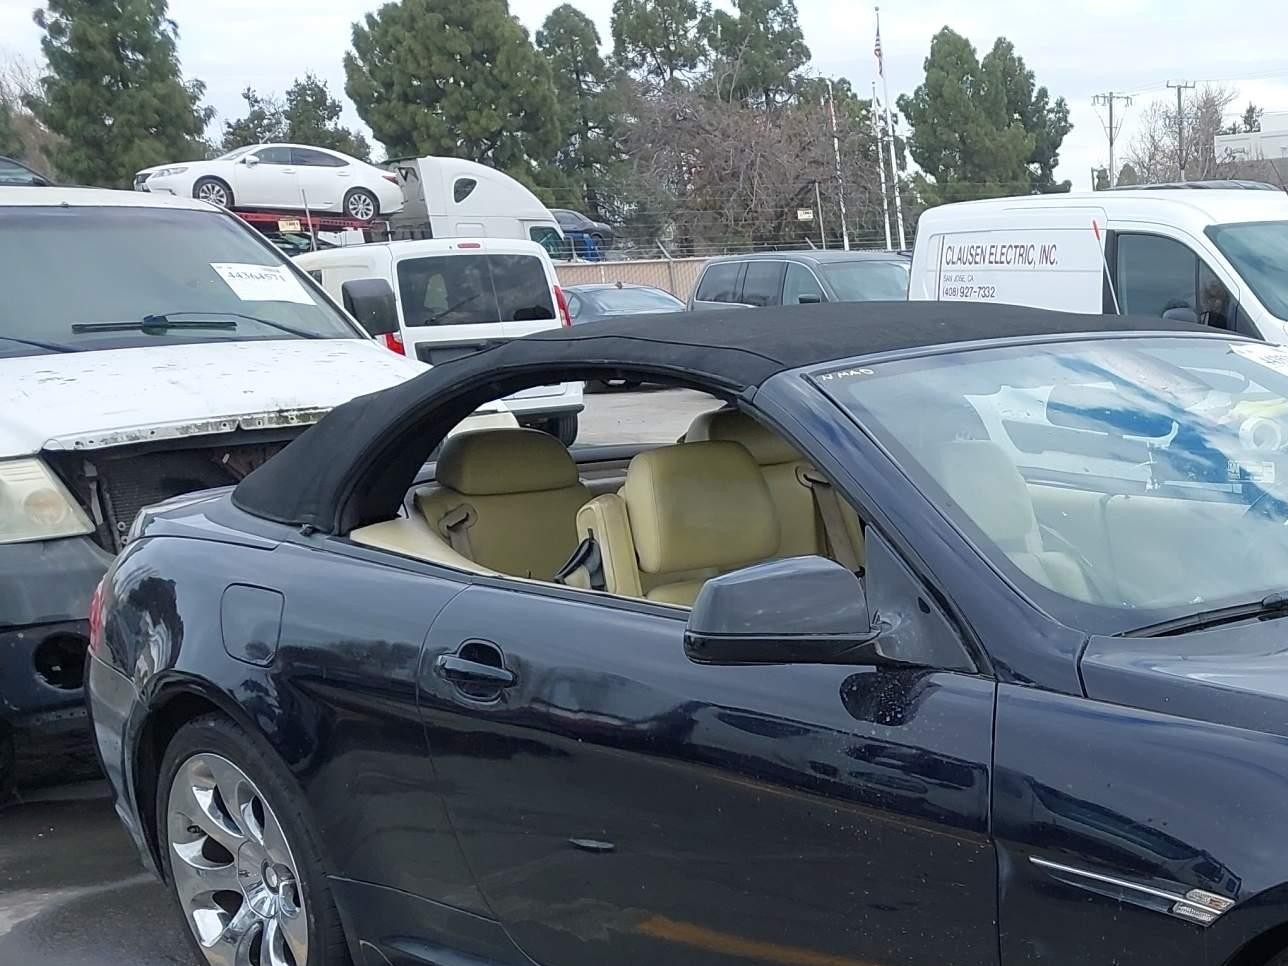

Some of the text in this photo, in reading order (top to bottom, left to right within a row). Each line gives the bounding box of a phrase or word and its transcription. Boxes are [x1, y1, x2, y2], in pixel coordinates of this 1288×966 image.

[945, 244, 1058, 268] CLAUSEN ELECTRIC, INC.
[960, 286, 996, 298] 927-7332
